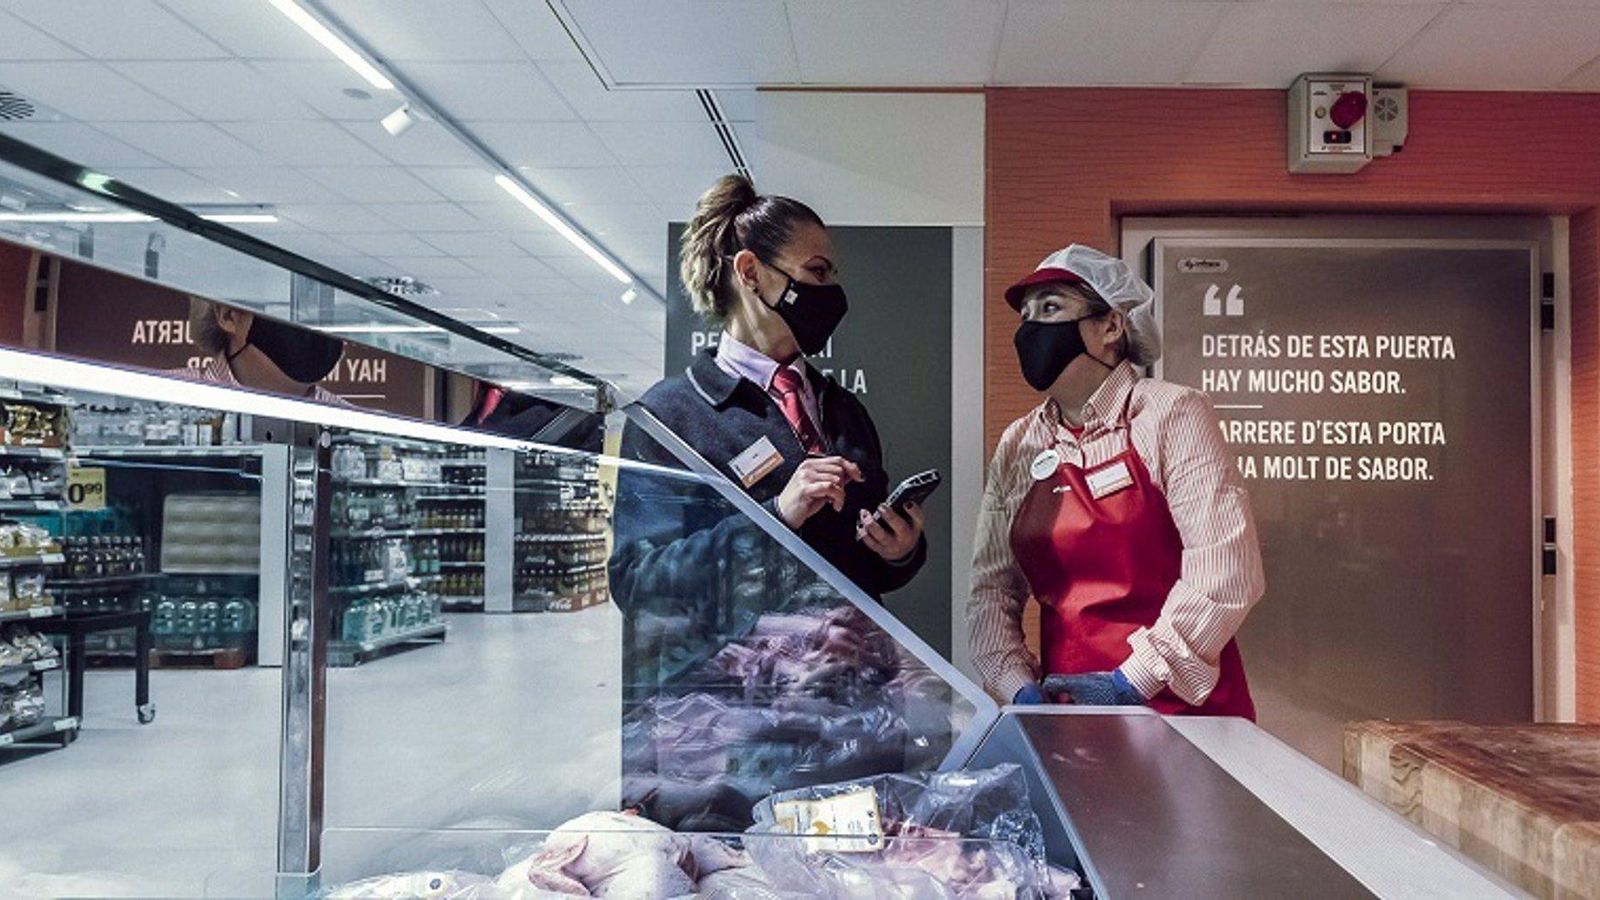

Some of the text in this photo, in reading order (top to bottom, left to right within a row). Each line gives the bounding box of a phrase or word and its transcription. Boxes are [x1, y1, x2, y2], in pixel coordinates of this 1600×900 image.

[1202, 329, 1455, 360] DETRÁS DE ESTA PUERTA
[1202, 369, 1406, 395] HAY MUCHO SABOR.
[1302, 419, 1373, 446] D'ESTA
[1378, 421, 1446, 446] PORTA
[1263, 455, 1320, 480] MOLT
[1325, 456, 1352, 480] DE
[1357, 456, 1434, 481] SABOR.
